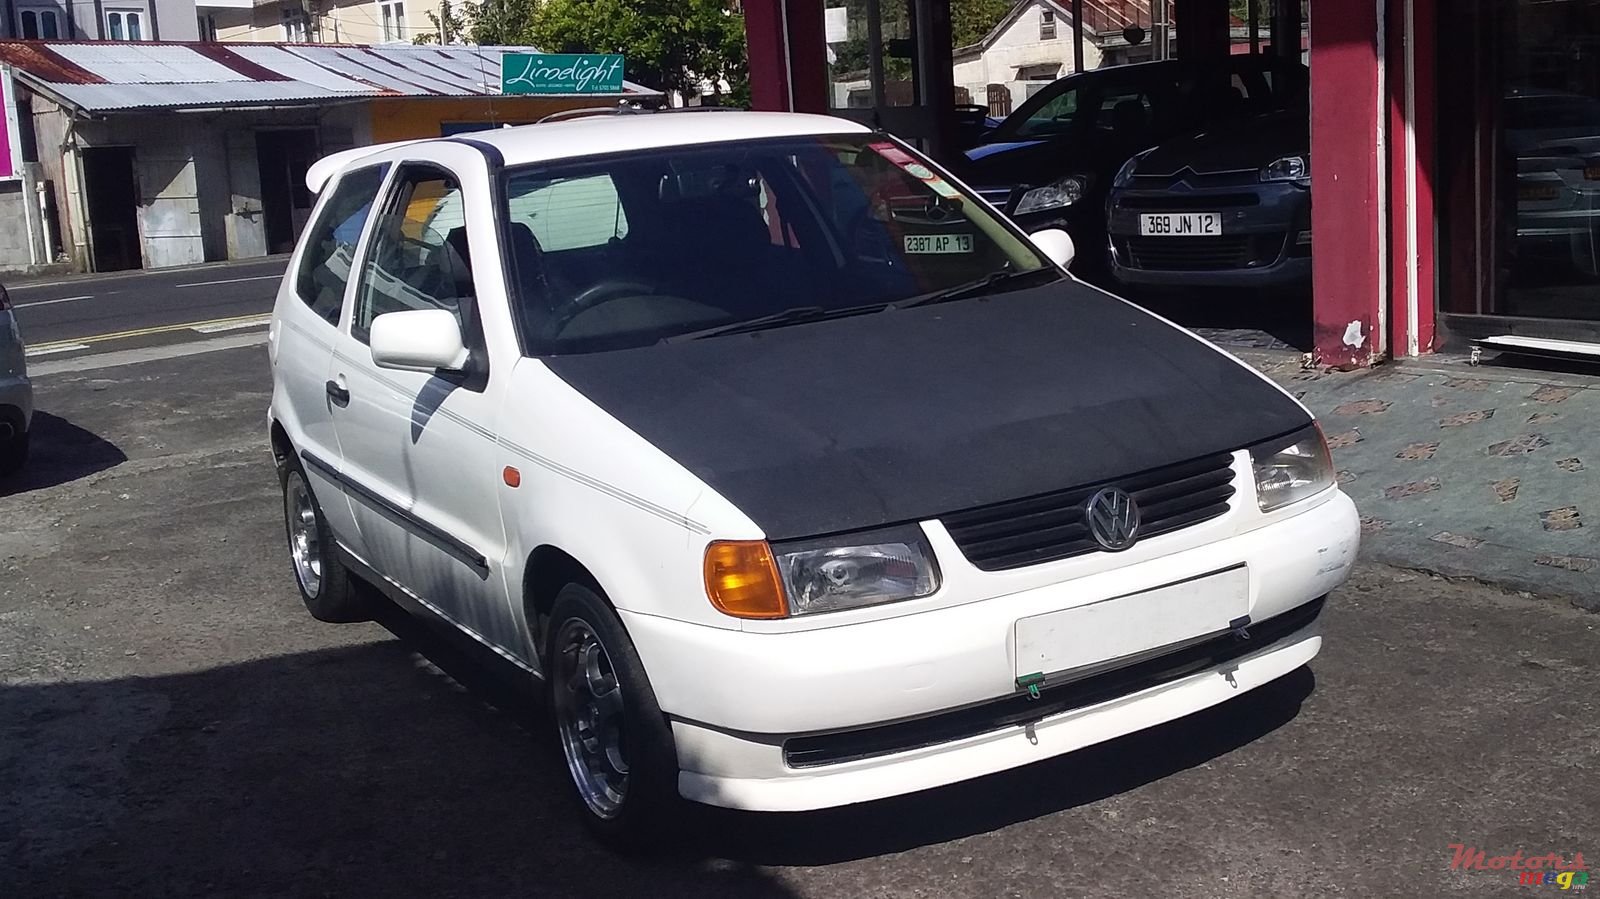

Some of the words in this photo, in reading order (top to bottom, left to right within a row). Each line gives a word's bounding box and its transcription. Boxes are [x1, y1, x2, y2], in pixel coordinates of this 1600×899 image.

[505, 56, 621, 91] Limelight
[1148, 216, 1170, 233] 369
[1175, 216, 1192, 233] JN
[1198, 215, 1213, 233] 12
[906, 237, 930, 251] 2387
[936, 237, 949, 251] AP
[955, 236, 969, 251] 13
